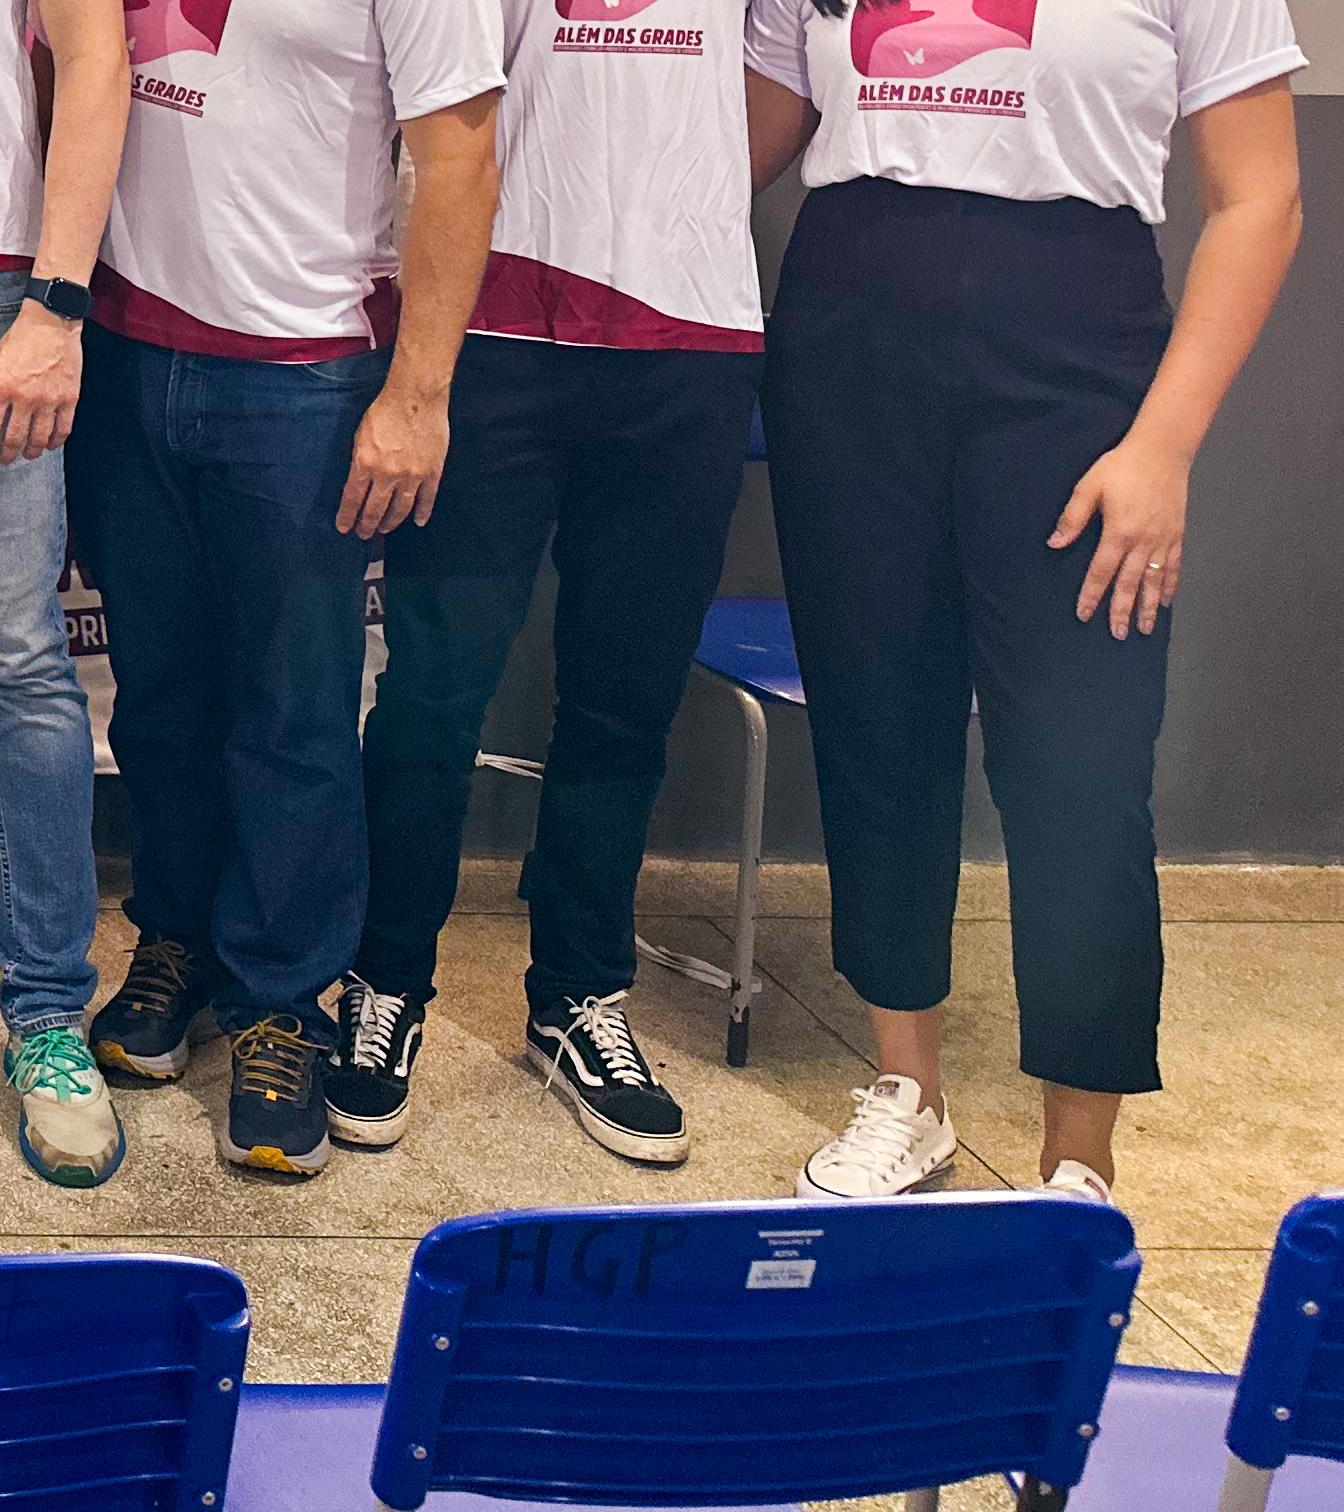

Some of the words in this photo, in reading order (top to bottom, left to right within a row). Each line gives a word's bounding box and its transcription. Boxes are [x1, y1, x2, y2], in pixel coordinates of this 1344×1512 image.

[554, 24, 600, 43] ALÉM
[603, 28, 636, 44] DAS
[640, 29, 703, 46] GRADES
[144, 78, 206, 108] GRADES
[858, 82, 904, 101] ALÉM
[908, 85, 946, 102] DAS
[950, 88, 1025, 108] GRADES
[64, 614, 108, 647] PRI
